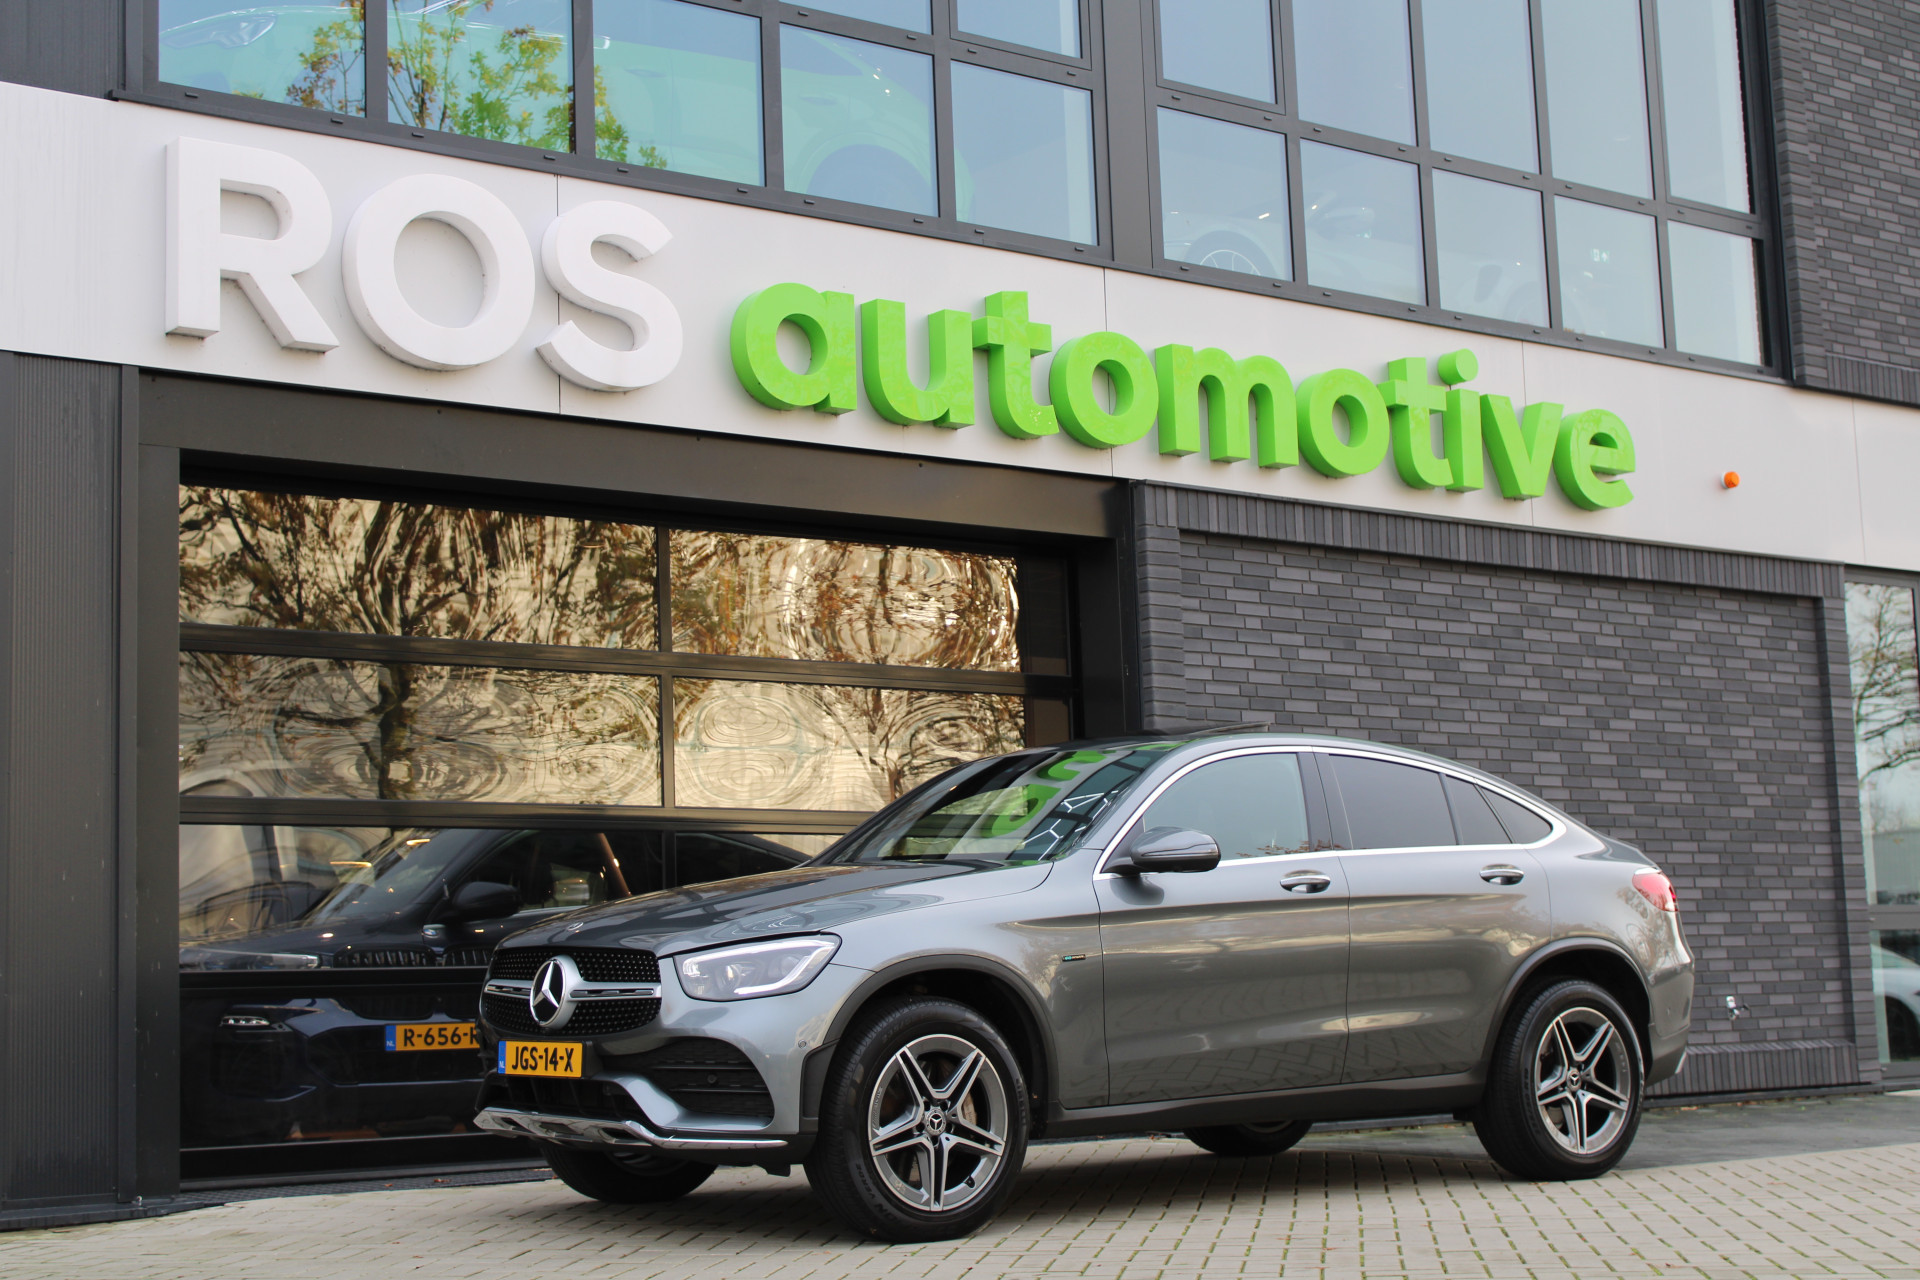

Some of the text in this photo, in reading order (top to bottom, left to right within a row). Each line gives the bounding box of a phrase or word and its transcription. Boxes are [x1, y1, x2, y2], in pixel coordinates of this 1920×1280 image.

[165, 136, 1636, 511] ROS automotive
[511, 1046, 574, 1072] JGS-14-X
